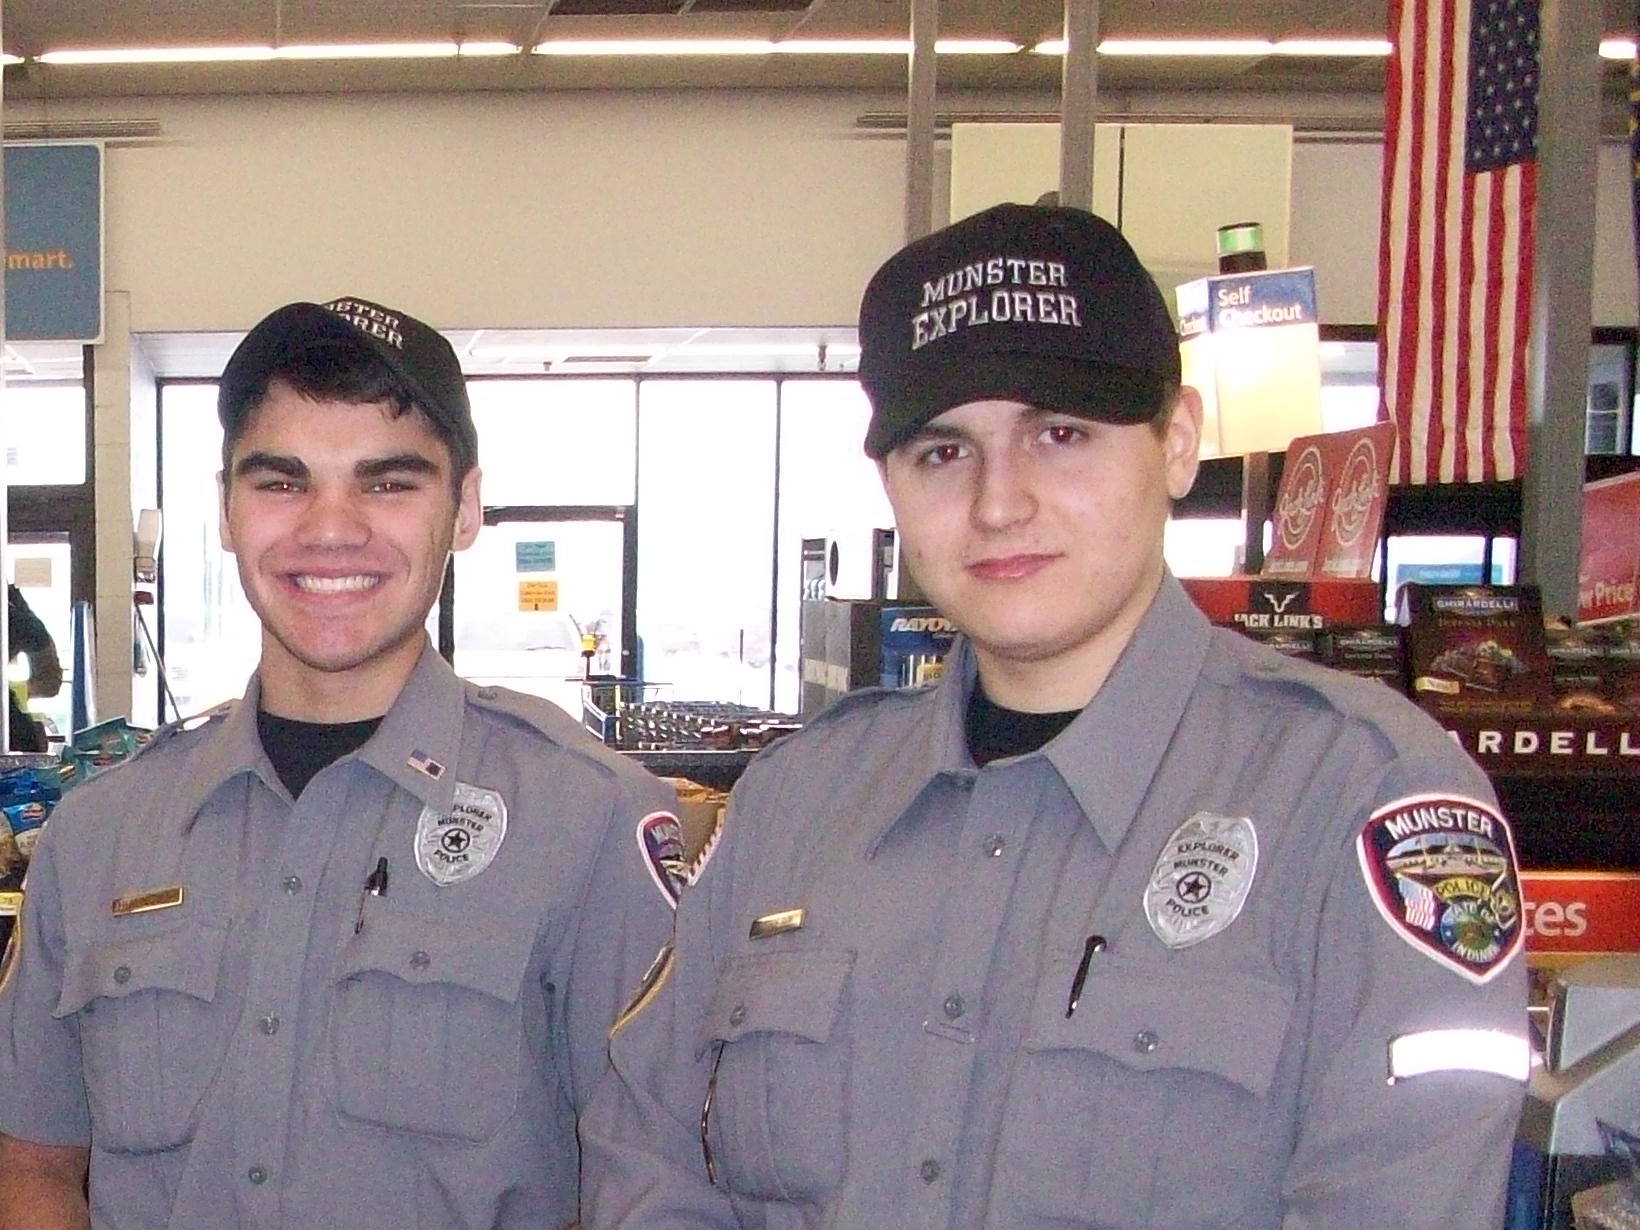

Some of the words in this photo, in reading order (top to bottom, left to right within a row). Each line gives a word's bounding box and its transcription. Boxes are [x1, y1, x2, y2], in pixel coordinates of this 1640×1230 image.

[6, 250, 73, 269] mart.
[921, 257, 1068, 308] MUNSTER
[1218, 285, 1251, 307] Self
[328, 300, 400, 328] STER
[911, 292, 1082, 351] EXPLORER
[1219, 303, 1303, 328] Checkout
[890, 618, 958, 632] RAYOV
[1447, 731, 1640, 754] RDELL
[453, 804, 492, 820] PLORER
[1385, 807, 1492, 840] MUNSTER
[433, 849, 469, 863] POLICE
[1178, 841, 1240, 860] EXPLORER
[1173, 859, 1228, 877] MUNSTER
[1165, 898, 1209, 917] POLICE
